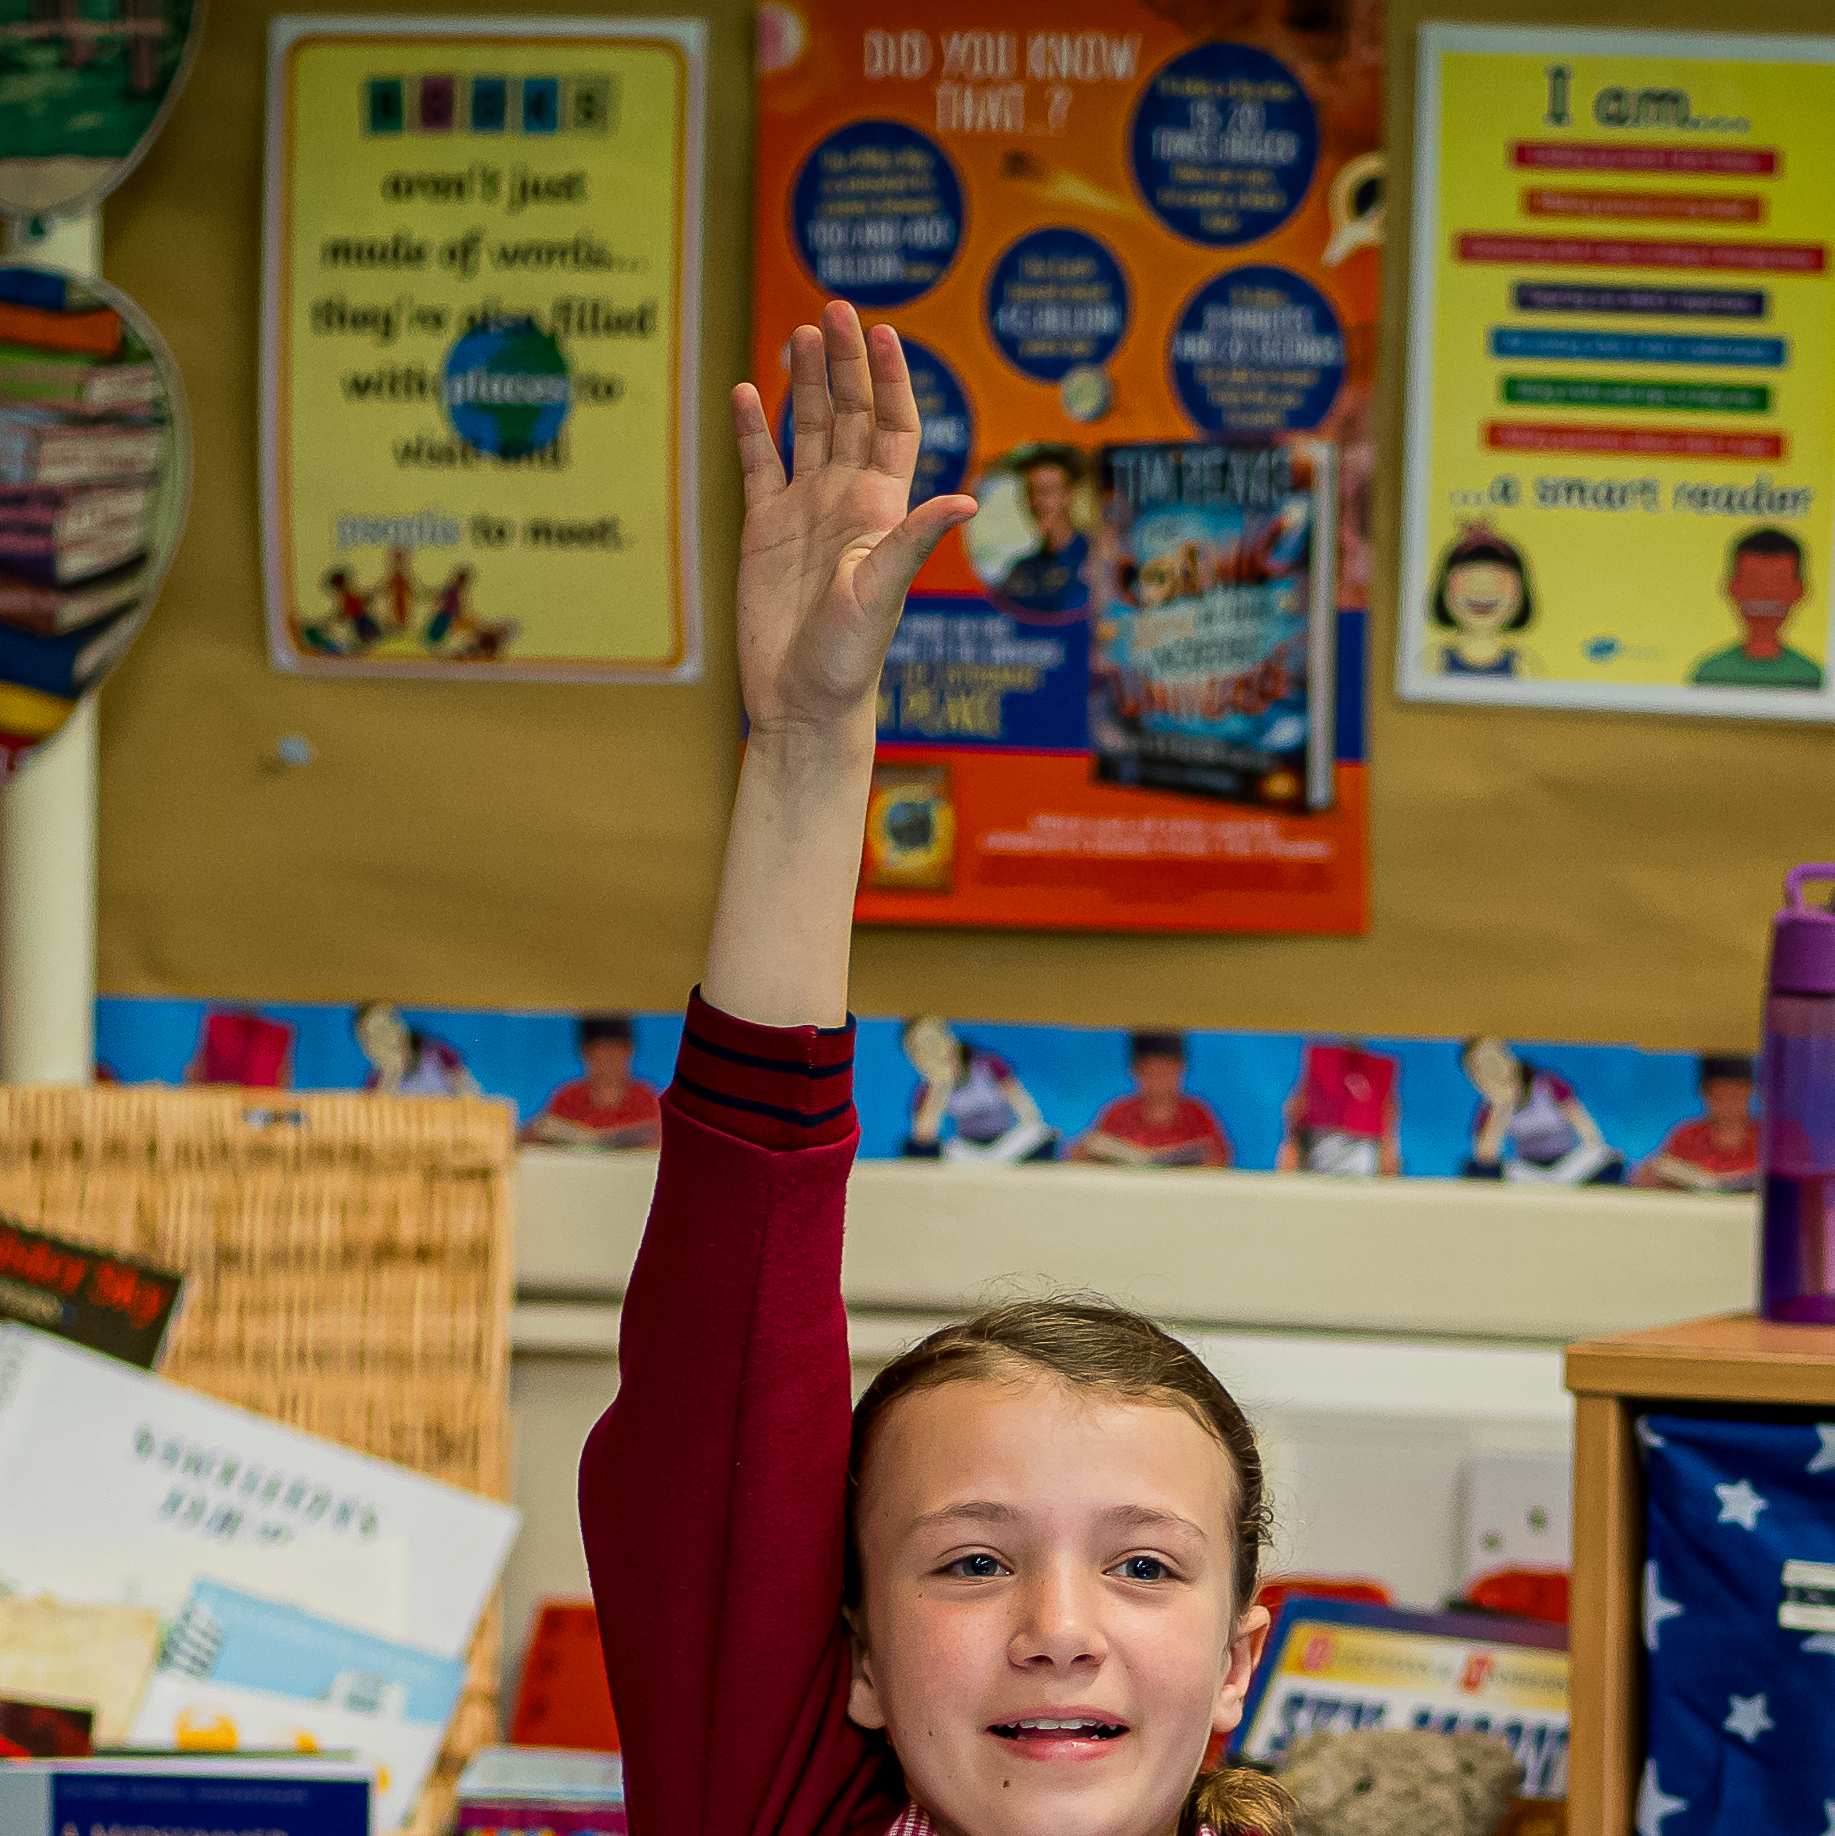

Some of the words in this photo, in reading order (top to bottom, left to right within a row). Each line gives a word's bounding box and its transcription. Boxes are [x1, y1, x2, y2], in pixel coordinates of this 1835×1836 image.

[864, 28, 932, 79] DID
[941, 31, 1018, 79] YOU
[1026, 32, 1140, 81] KNOW
[1545, 65, 1571, 127] I
[508, 166, 587, 213] just
[320, 229, 428, 268] made
[440, 226, 486, 278] of
